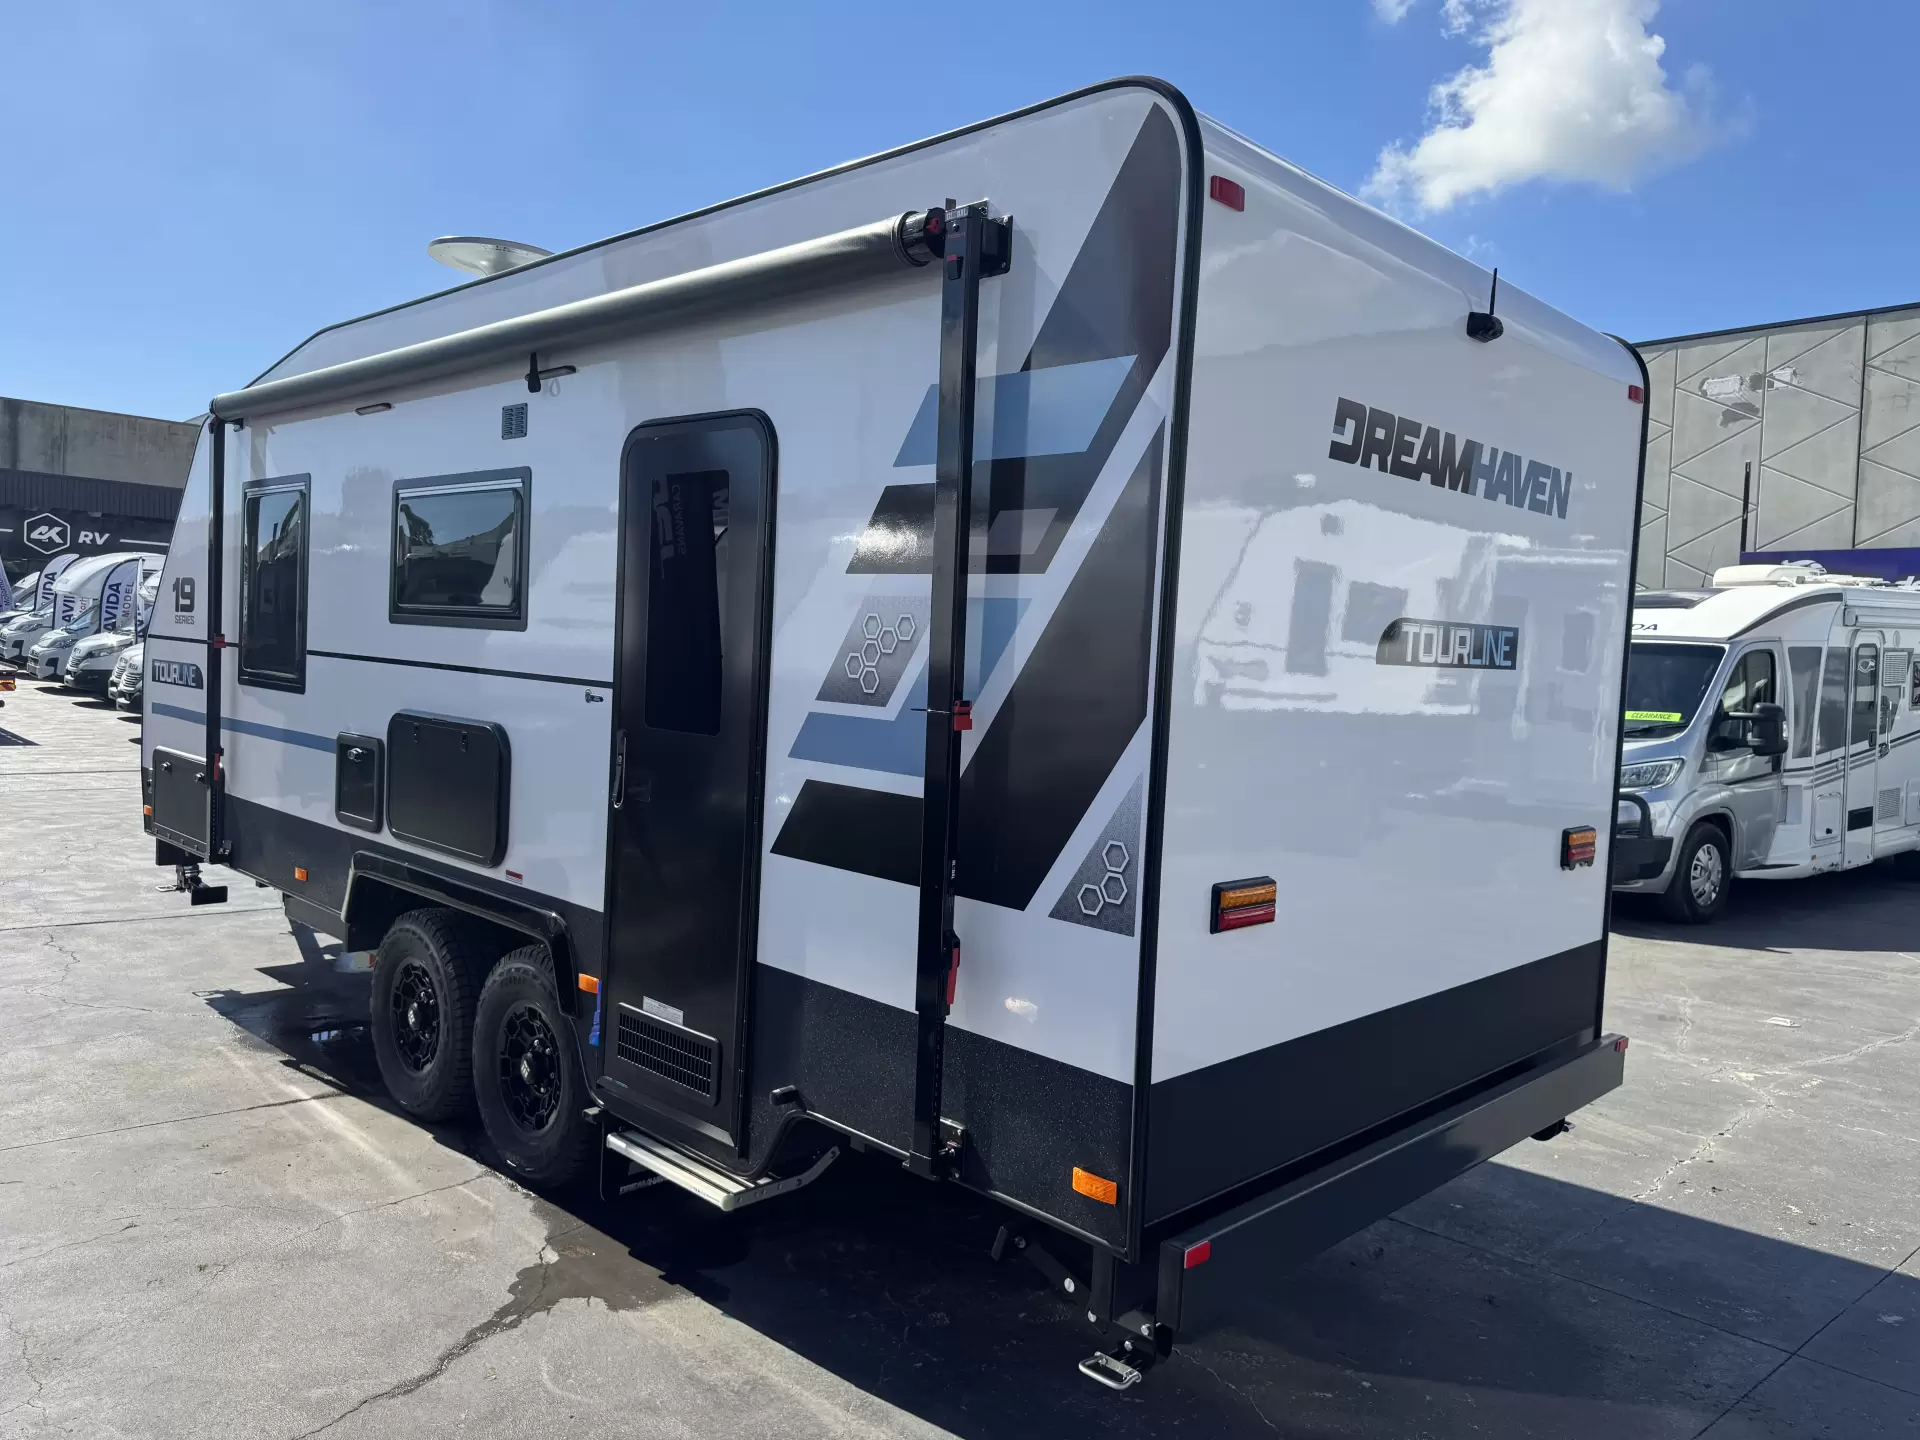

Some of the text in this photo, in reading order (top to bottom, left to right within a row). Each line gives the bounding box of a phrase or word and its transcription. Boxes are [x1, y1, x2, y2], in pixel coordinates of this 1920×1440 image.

[1328, 396, 1573, 520] DREAMHAVEN
[30, 525, 111, 545] 4K RV
[103, 582, 122, 632] AVIDA
[121, 581, 135, 618] MODEL
[172, 577, 196, 613] 19
[174, 615, 195, 625] SERIES
[1401, 622, 1514, 667] TOURLINE
[153, 661, 197, 687] TOURLINE
[1630, 712, 1673, 720] CLEARANCE
